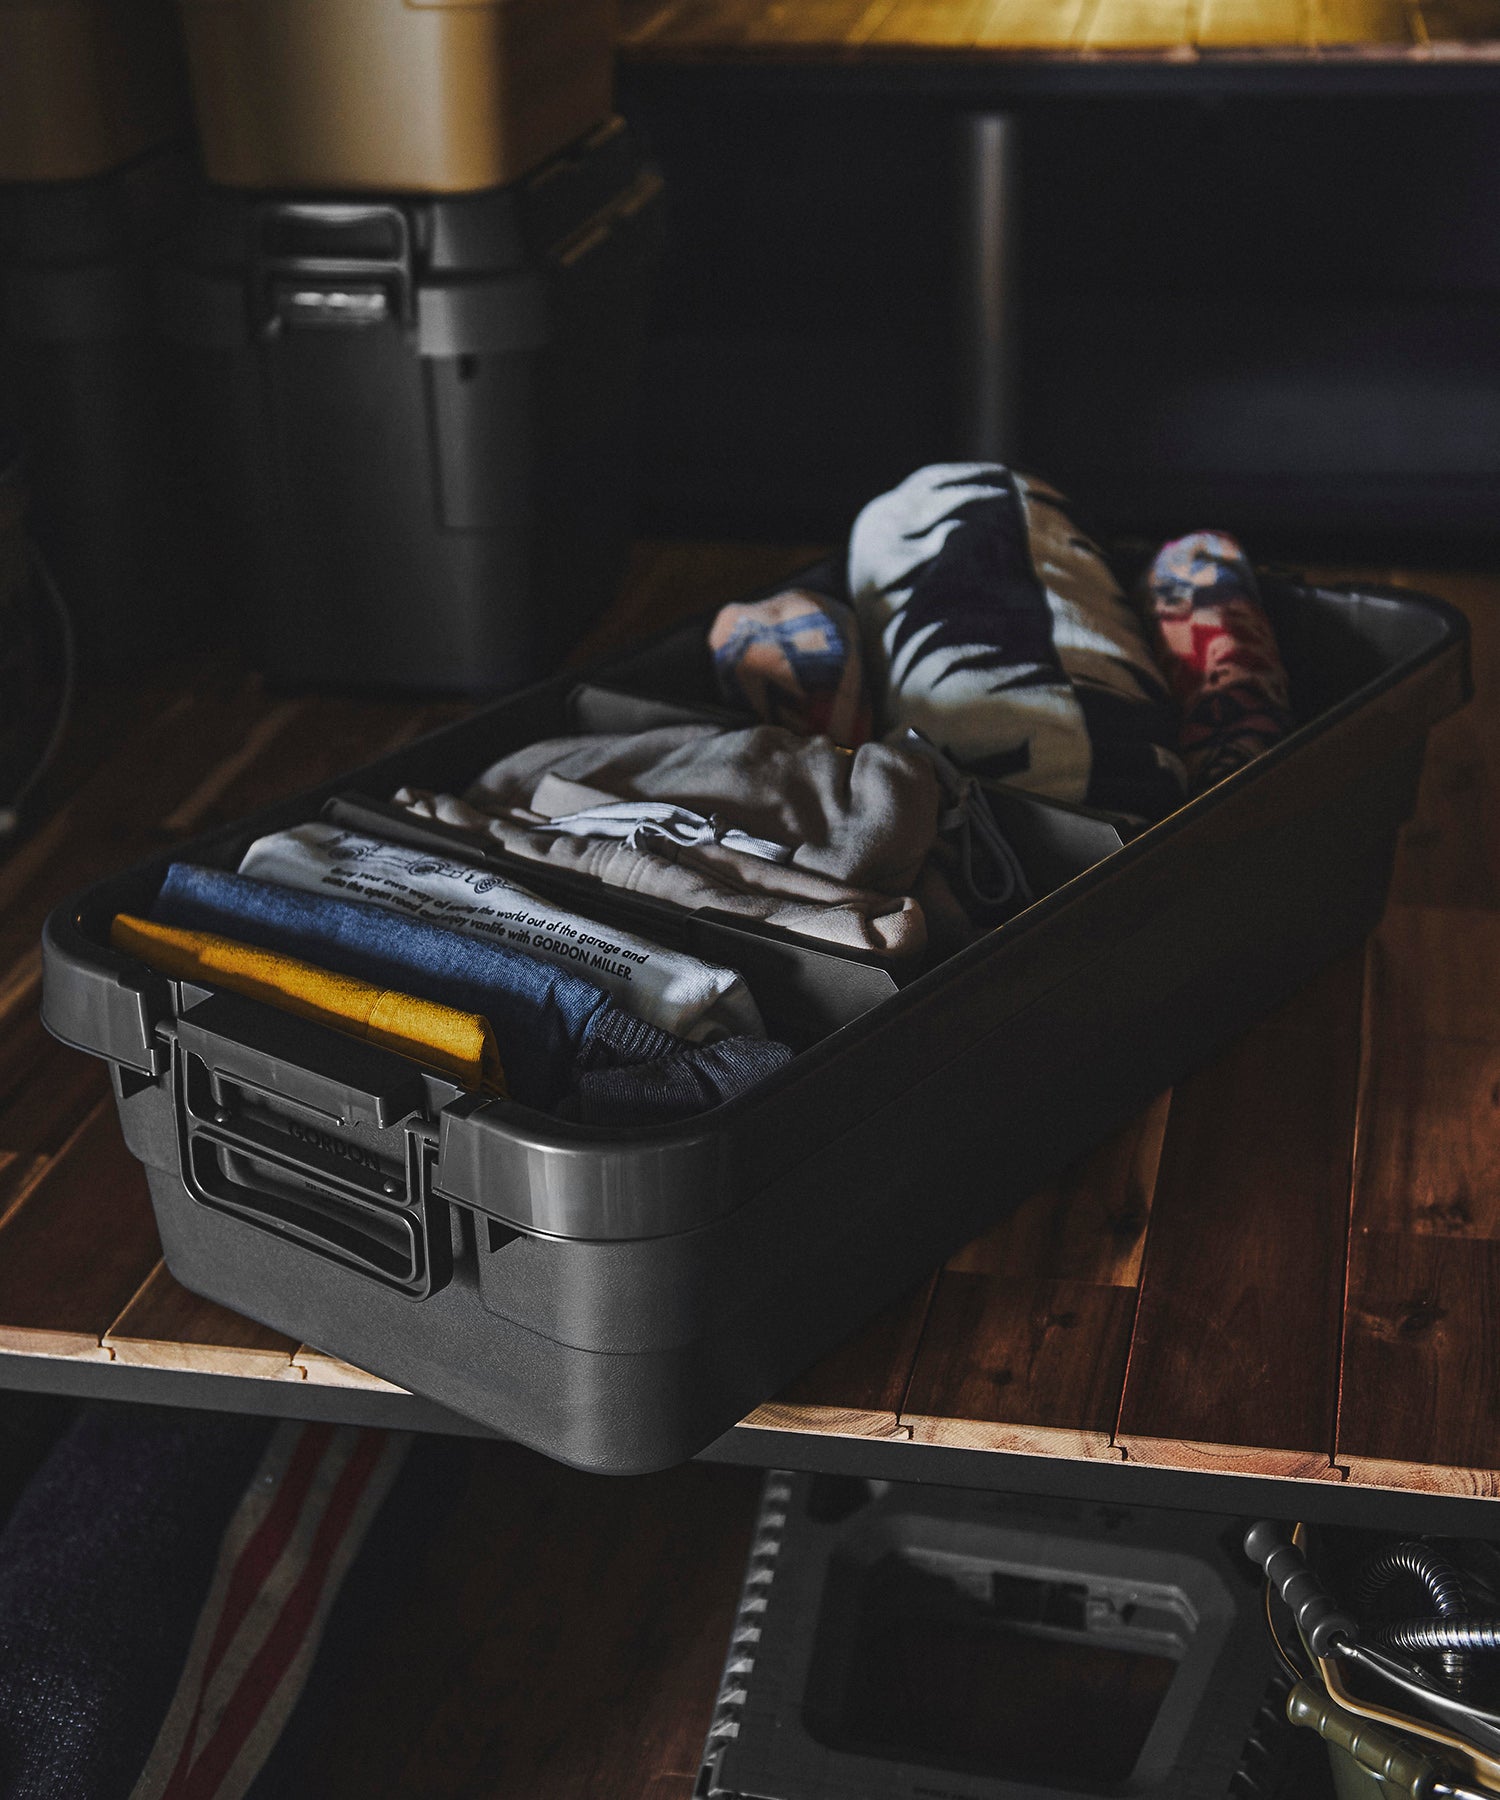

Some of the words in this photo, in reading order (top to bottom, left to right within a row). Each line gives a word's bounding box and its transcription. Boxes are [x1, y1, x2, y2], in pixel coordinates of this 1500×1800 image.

[409, 888, 435, 903] way
[433, 900, 452, 909] of
[478, 905, 495, 916] the
[497, 909, 528, 923] world
[527, 917, 546, 930] out
[546, 921, 562, 933] of
[559, 923, 578, 938] the
[577, 933, 621, 955] garage
[622, 948, 650, 965] and
[470, 917, 506, 937] vanlife
[508, 928, 531, 945] with
[533, 935, 590, 963] GORDON
[589, 953, 633, 981] MILLER.
[288, 1121, 380, 1172] GORDON
